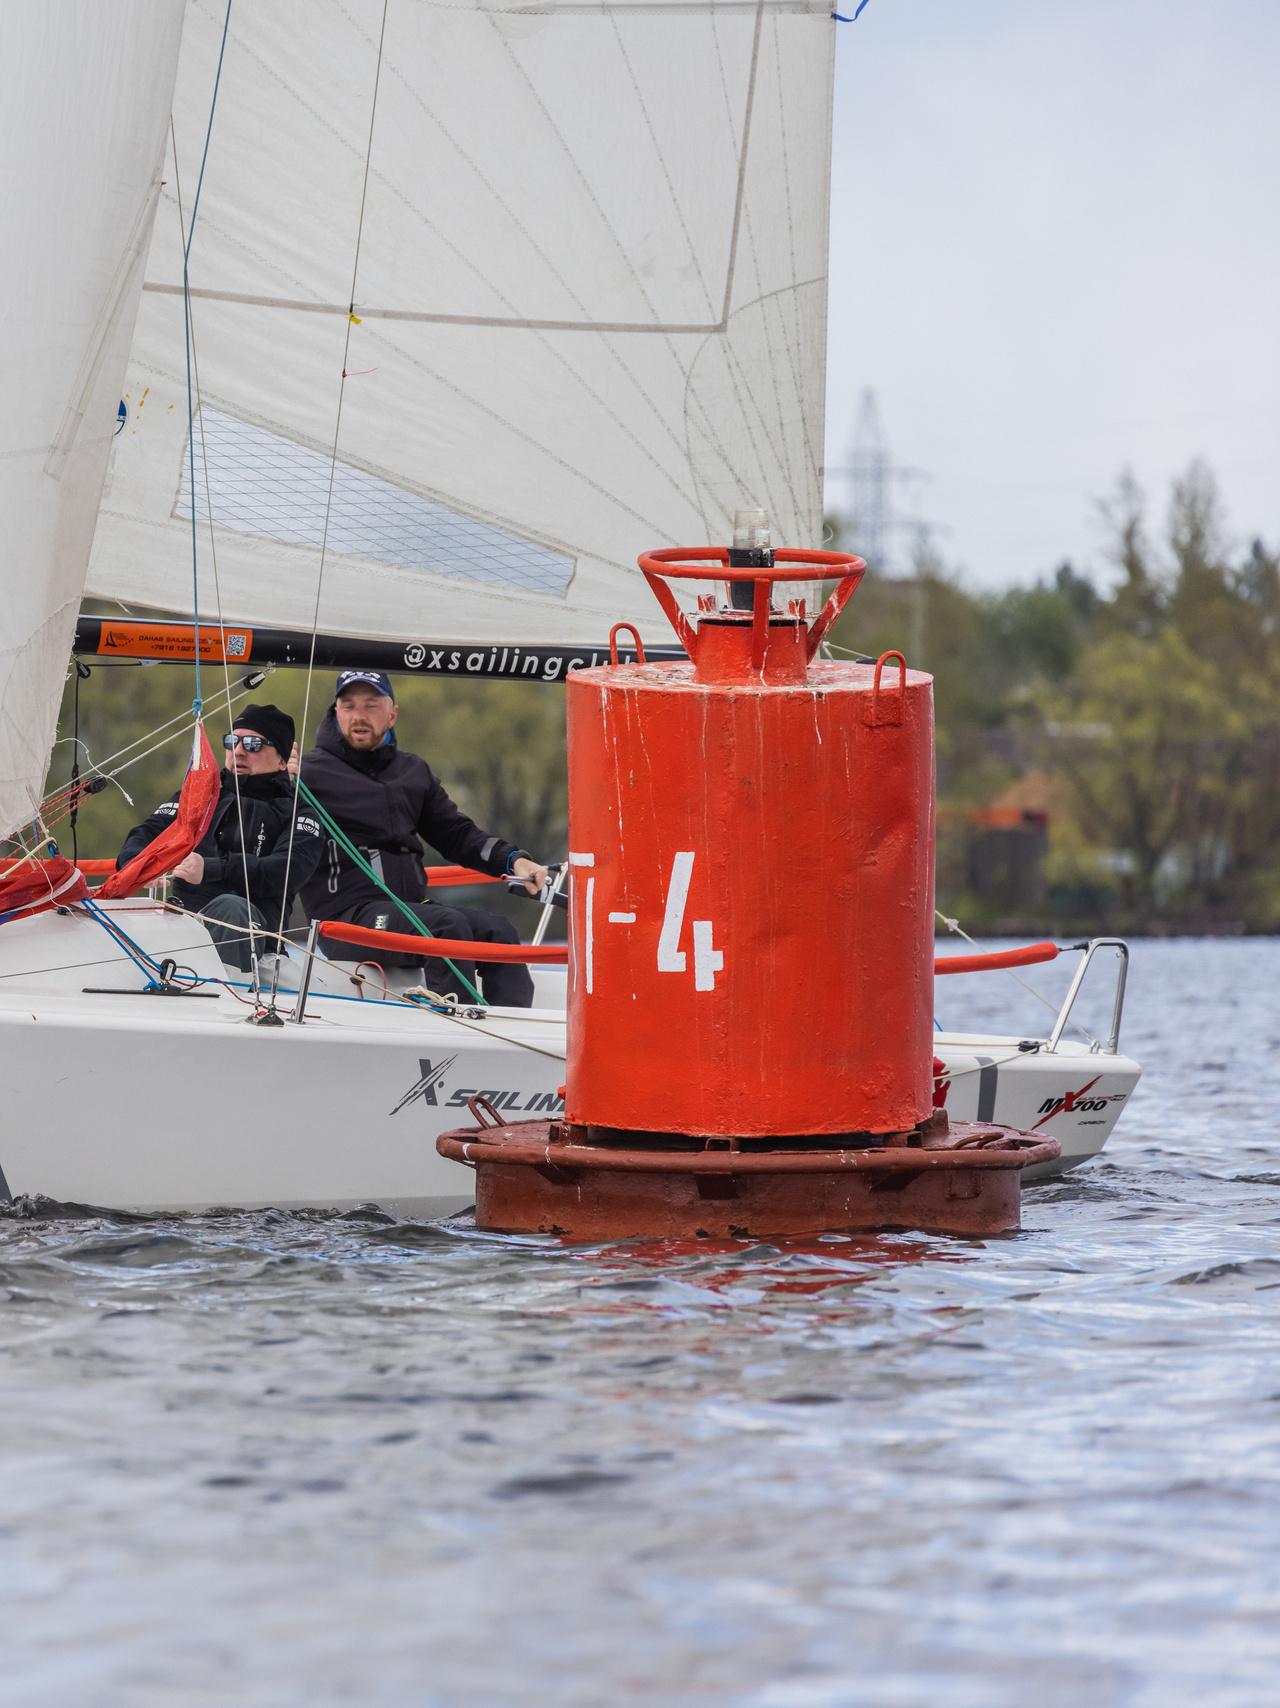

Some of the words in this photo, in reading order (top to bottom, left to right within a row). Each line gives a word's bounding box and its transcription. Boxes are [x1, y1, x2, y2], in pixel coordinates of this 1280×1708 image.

[165, 636, 194, 644] SAILING
[176, 645, 211, 653] 192700
[404, 643, 637, 681] @xsailingcl
